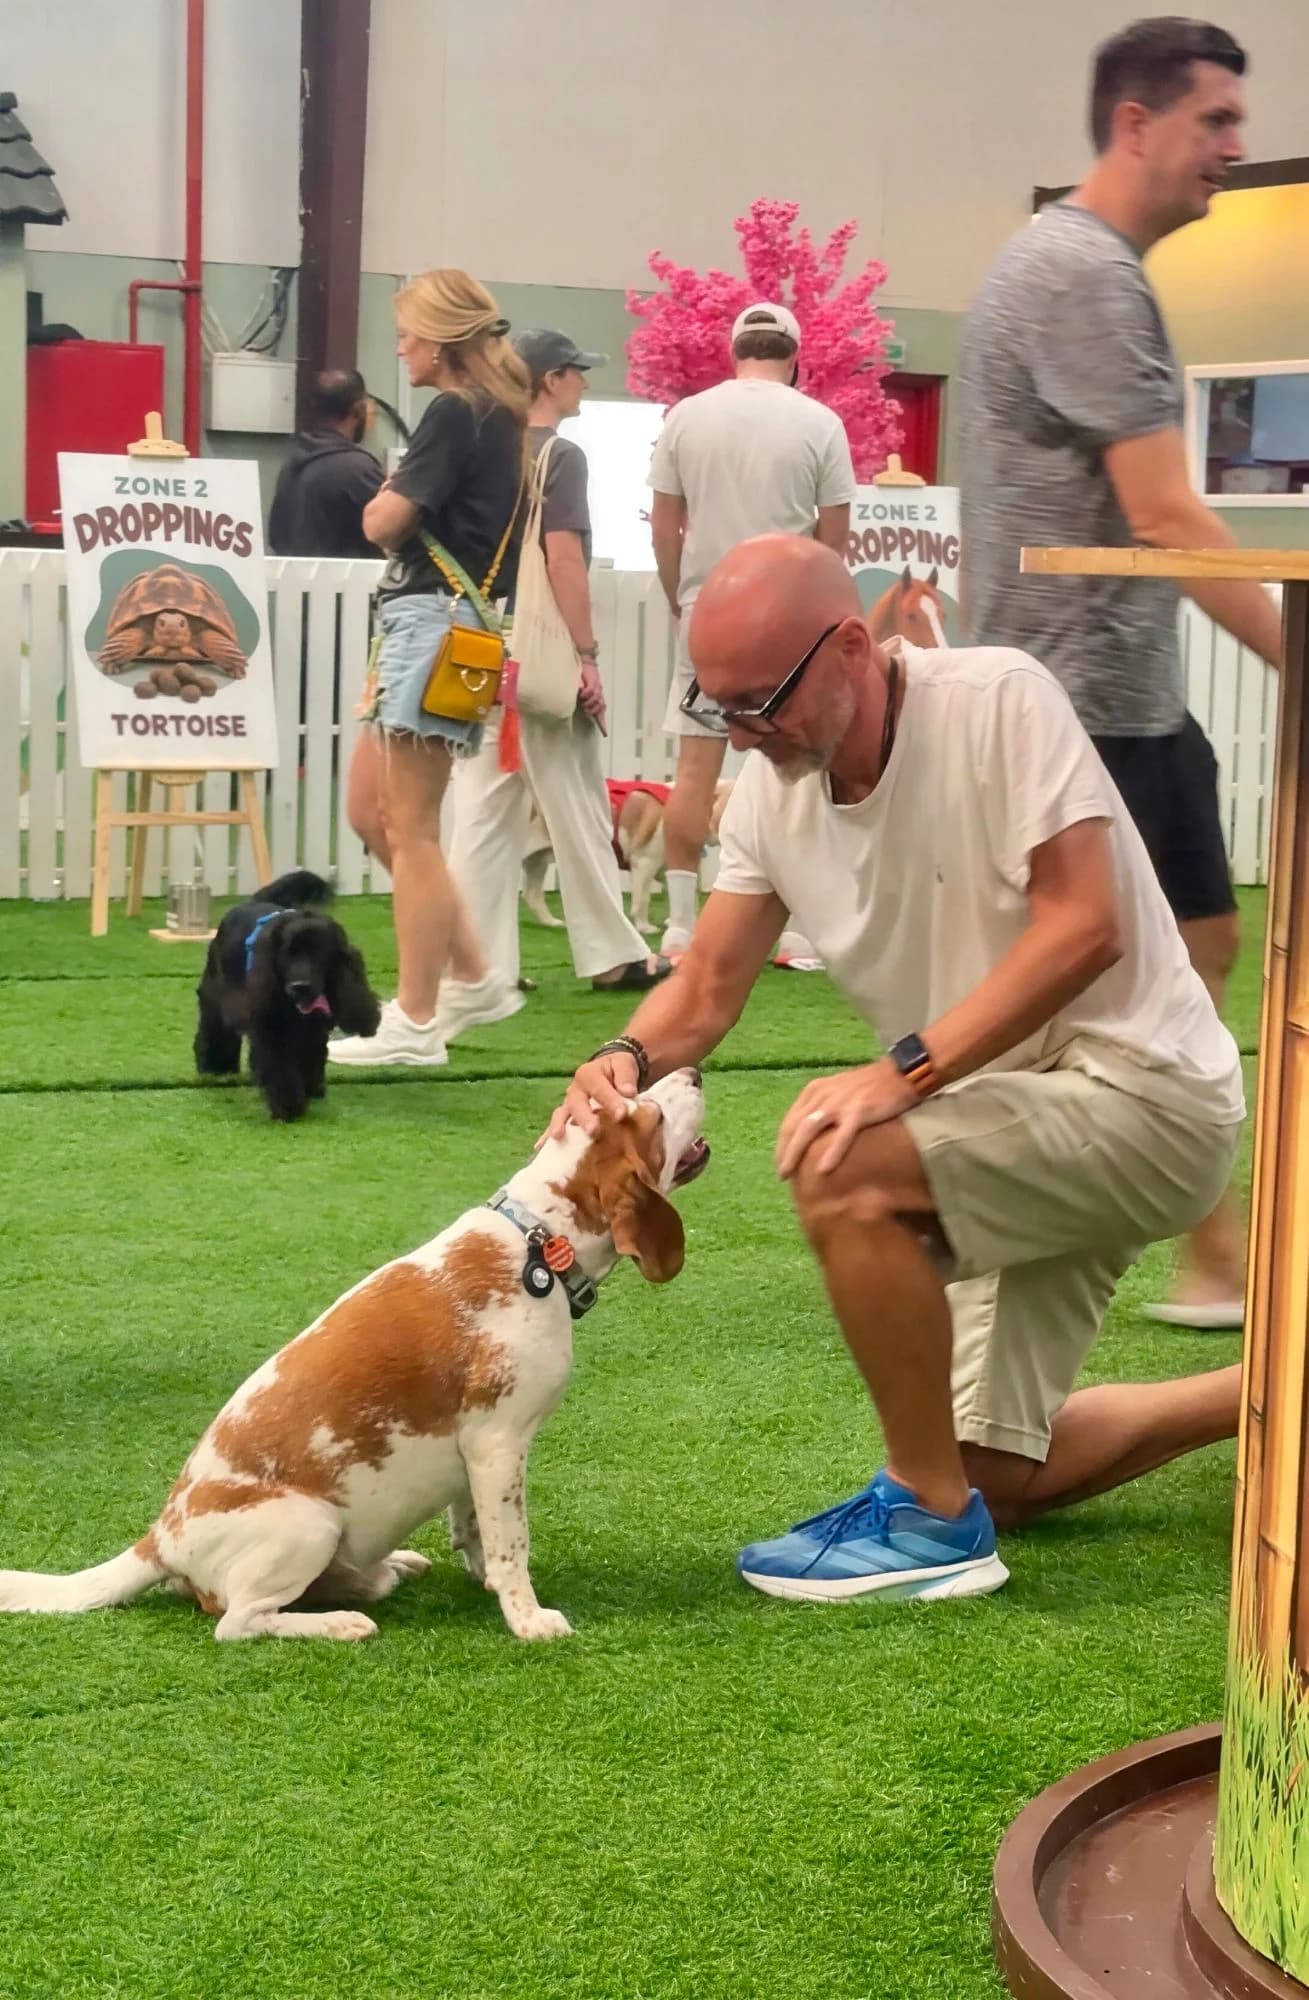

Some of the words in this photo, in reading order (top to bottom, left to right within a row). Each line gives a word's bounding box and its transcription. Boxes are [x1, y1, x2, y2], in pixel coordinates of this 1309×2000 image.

[114, 476, 187, 497] ZONE
[194, 479, 209, 498] 2
[856, 503, 919, 521] ZONE
[924, 505, 938, 521] 2
[72, 502, 254, 558] DROPPINGS
[842, 526, 961, 569] ROPPING
[110, 713, 248, 737] TORTOISE
